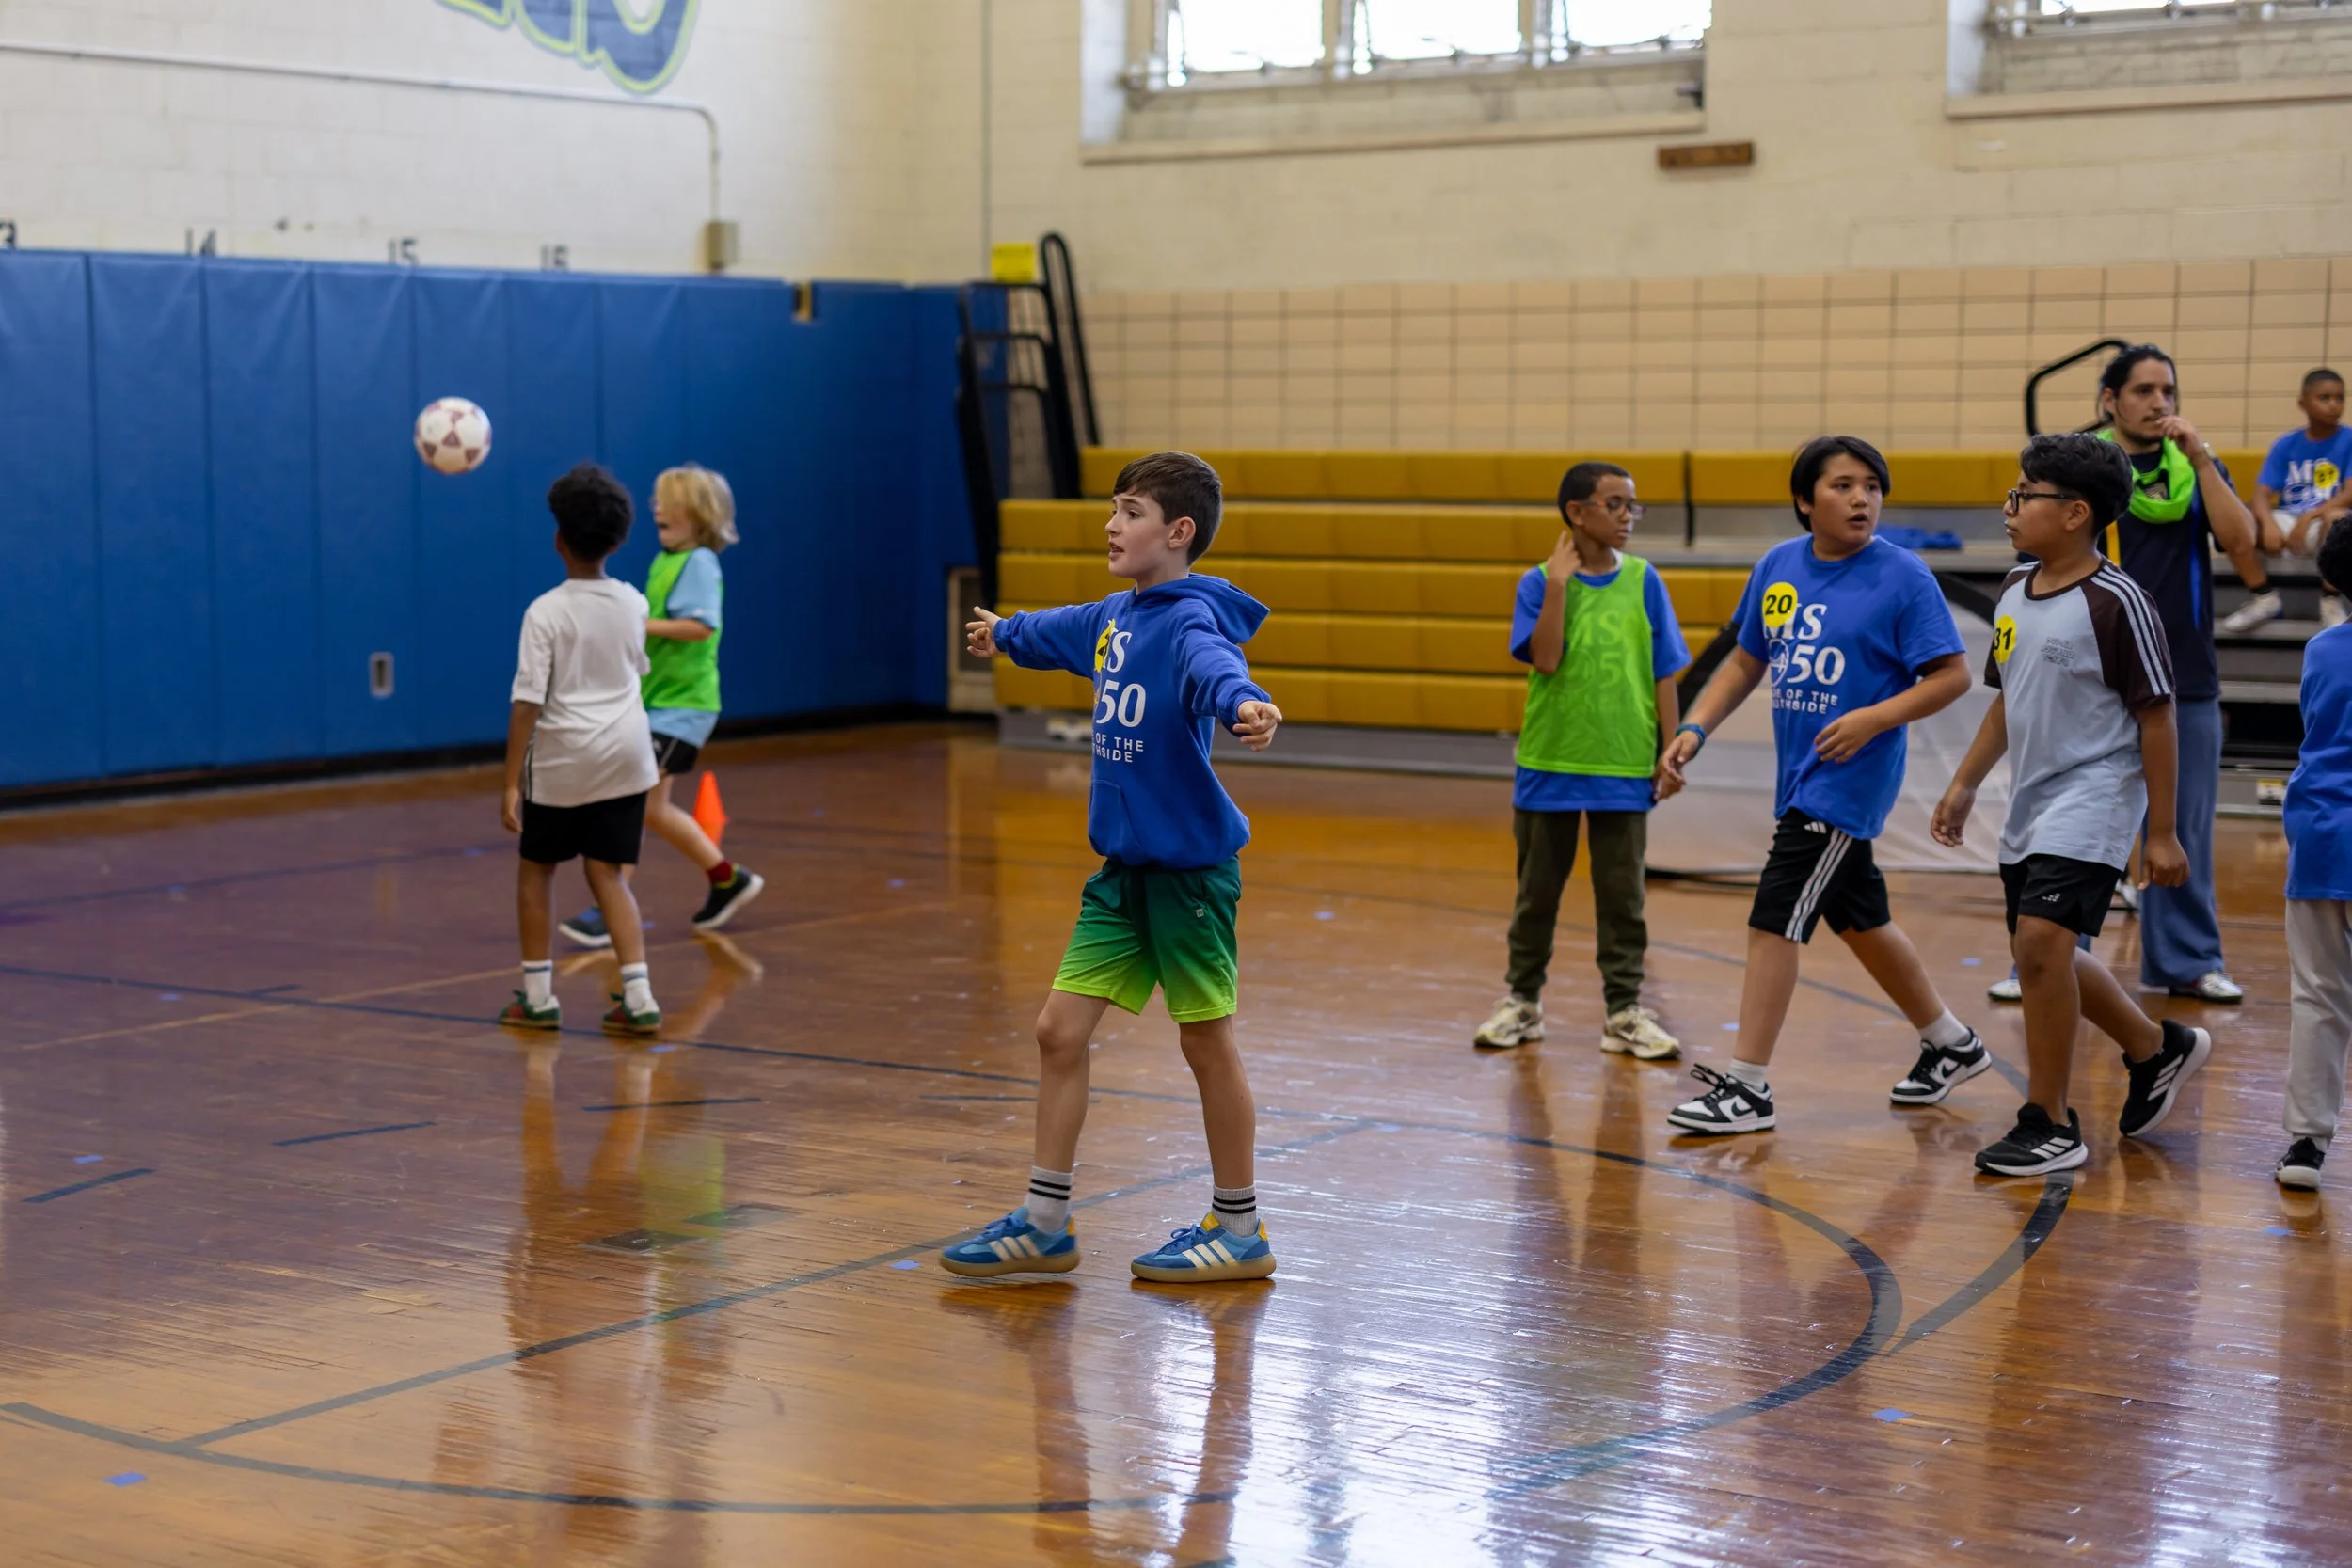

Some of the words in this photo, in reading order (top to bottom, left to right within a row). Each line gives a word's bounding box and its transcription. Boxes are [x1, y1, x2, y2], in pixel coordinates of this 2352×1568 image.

[1765, 594, 1792, 615] 20
[1994, 627, 2012, 650] 31
[1787, 643, 1846, 685] 50
[1096, 679, 1146, 728] 50
[1786, 689, 1803, 700] OF
[1811, 690, 1838, 706] THE
[1095, 732, 1106, 745] OF
[1114, 736, 1144, 752] THE
